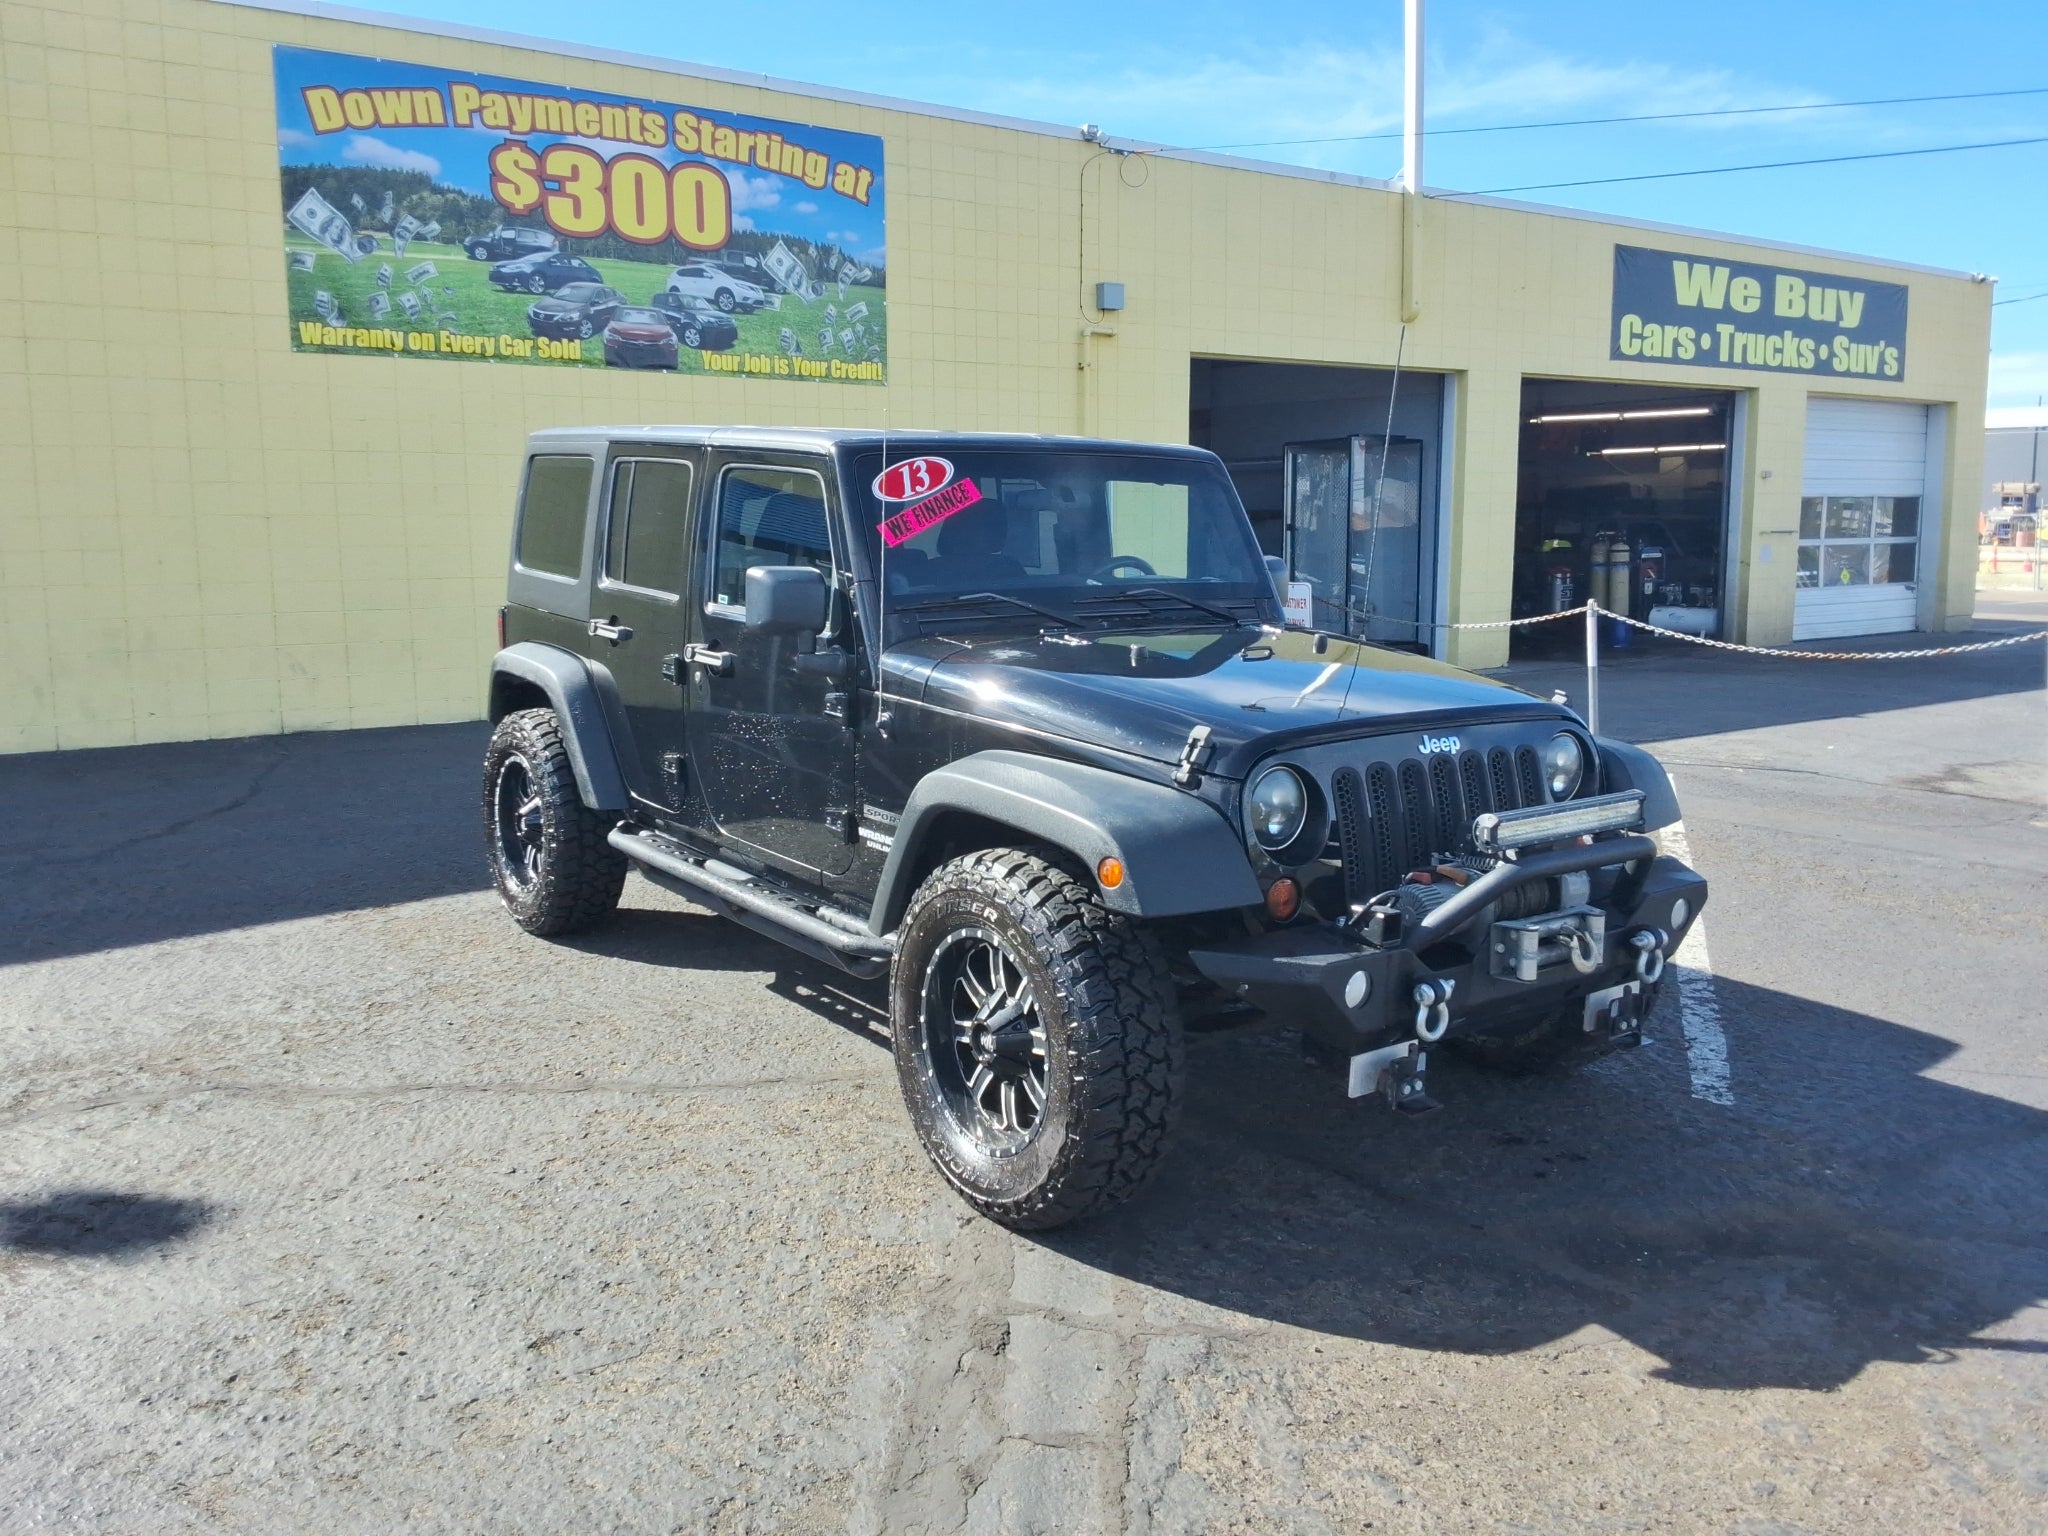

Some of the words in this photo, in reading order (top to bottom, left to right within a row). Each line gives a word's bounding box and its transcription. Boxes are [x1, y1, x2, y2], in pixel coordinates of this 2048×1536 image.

[302, 86, 447, 134] Down
[449, 81, 667, 148] Payments
[672, 110, 830, 190] Starting
[832, 162, 874, 206] at
[490, 139, 732, 251] $300
[1672, 260, 1761, 313] We
[1774, 274, 1865, 328] Buy
[299, 321, 404, 351] Warranty
[408, 332, 435, 351] on
[440, 331, 495, 357] Every
[500, 335, 533, 357] Car
[538, 336, 581, 361] Sold
[702, 350, 740, 371] Your
[743, 353, 771, 373] Job
[774, 356, 789, 375] is
[792, 356, 828, 377] Your
[831, 359, 882, 380] Credit!
[1620, 314, 1696, 360] Cars
[1716, 323, 1815, 369] Trucks
[1832, 335, 1899, 377] Suv's
[898, 460, 930, 498] 13
[885, 512, 912, 540] WE
[911, 482, 970, 528] FINANCE
[1418, 734, 1460, 755] Jeep
